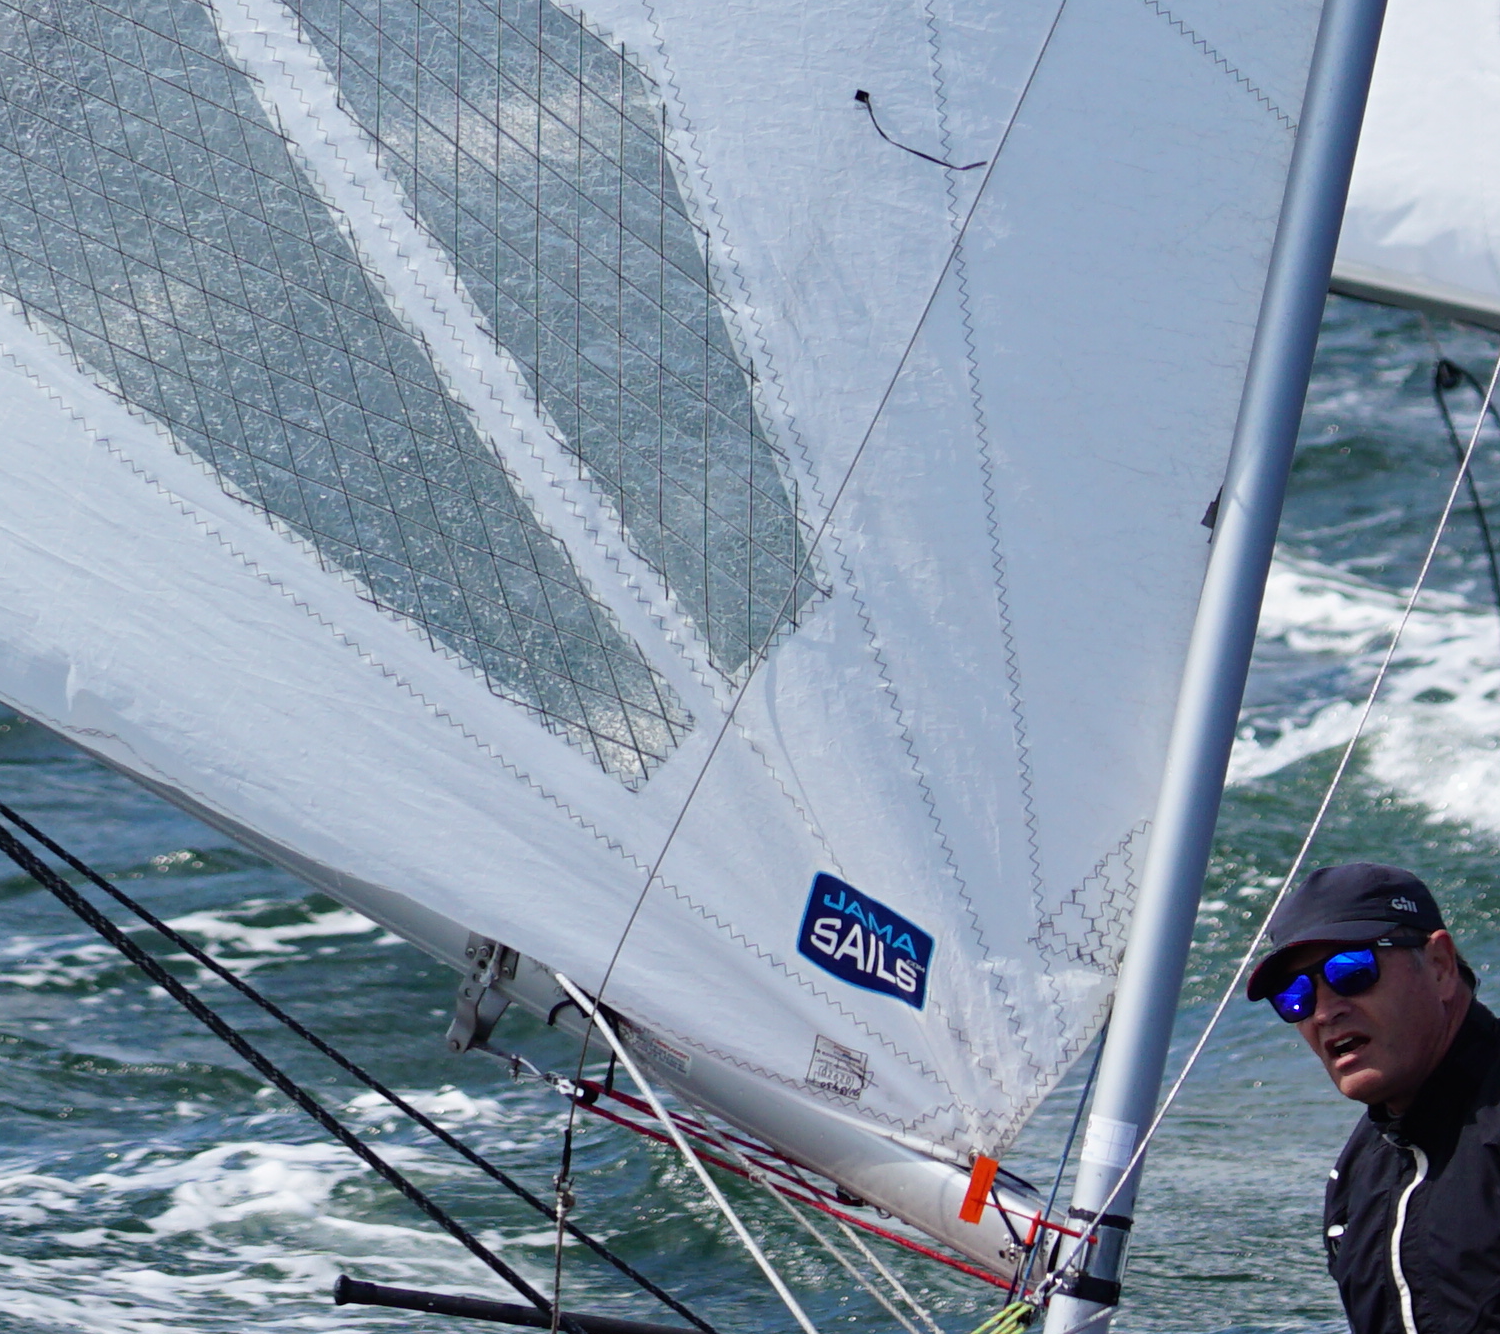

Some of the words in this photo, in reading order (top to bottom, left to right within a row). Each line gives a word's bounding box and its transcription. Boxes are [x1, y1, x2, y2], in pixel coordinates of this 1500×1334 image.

[823, 890, 918, 960] JAMA
[1391, 896, 1418, 913] Gill
[810, 917, 918, 993] SAILS
